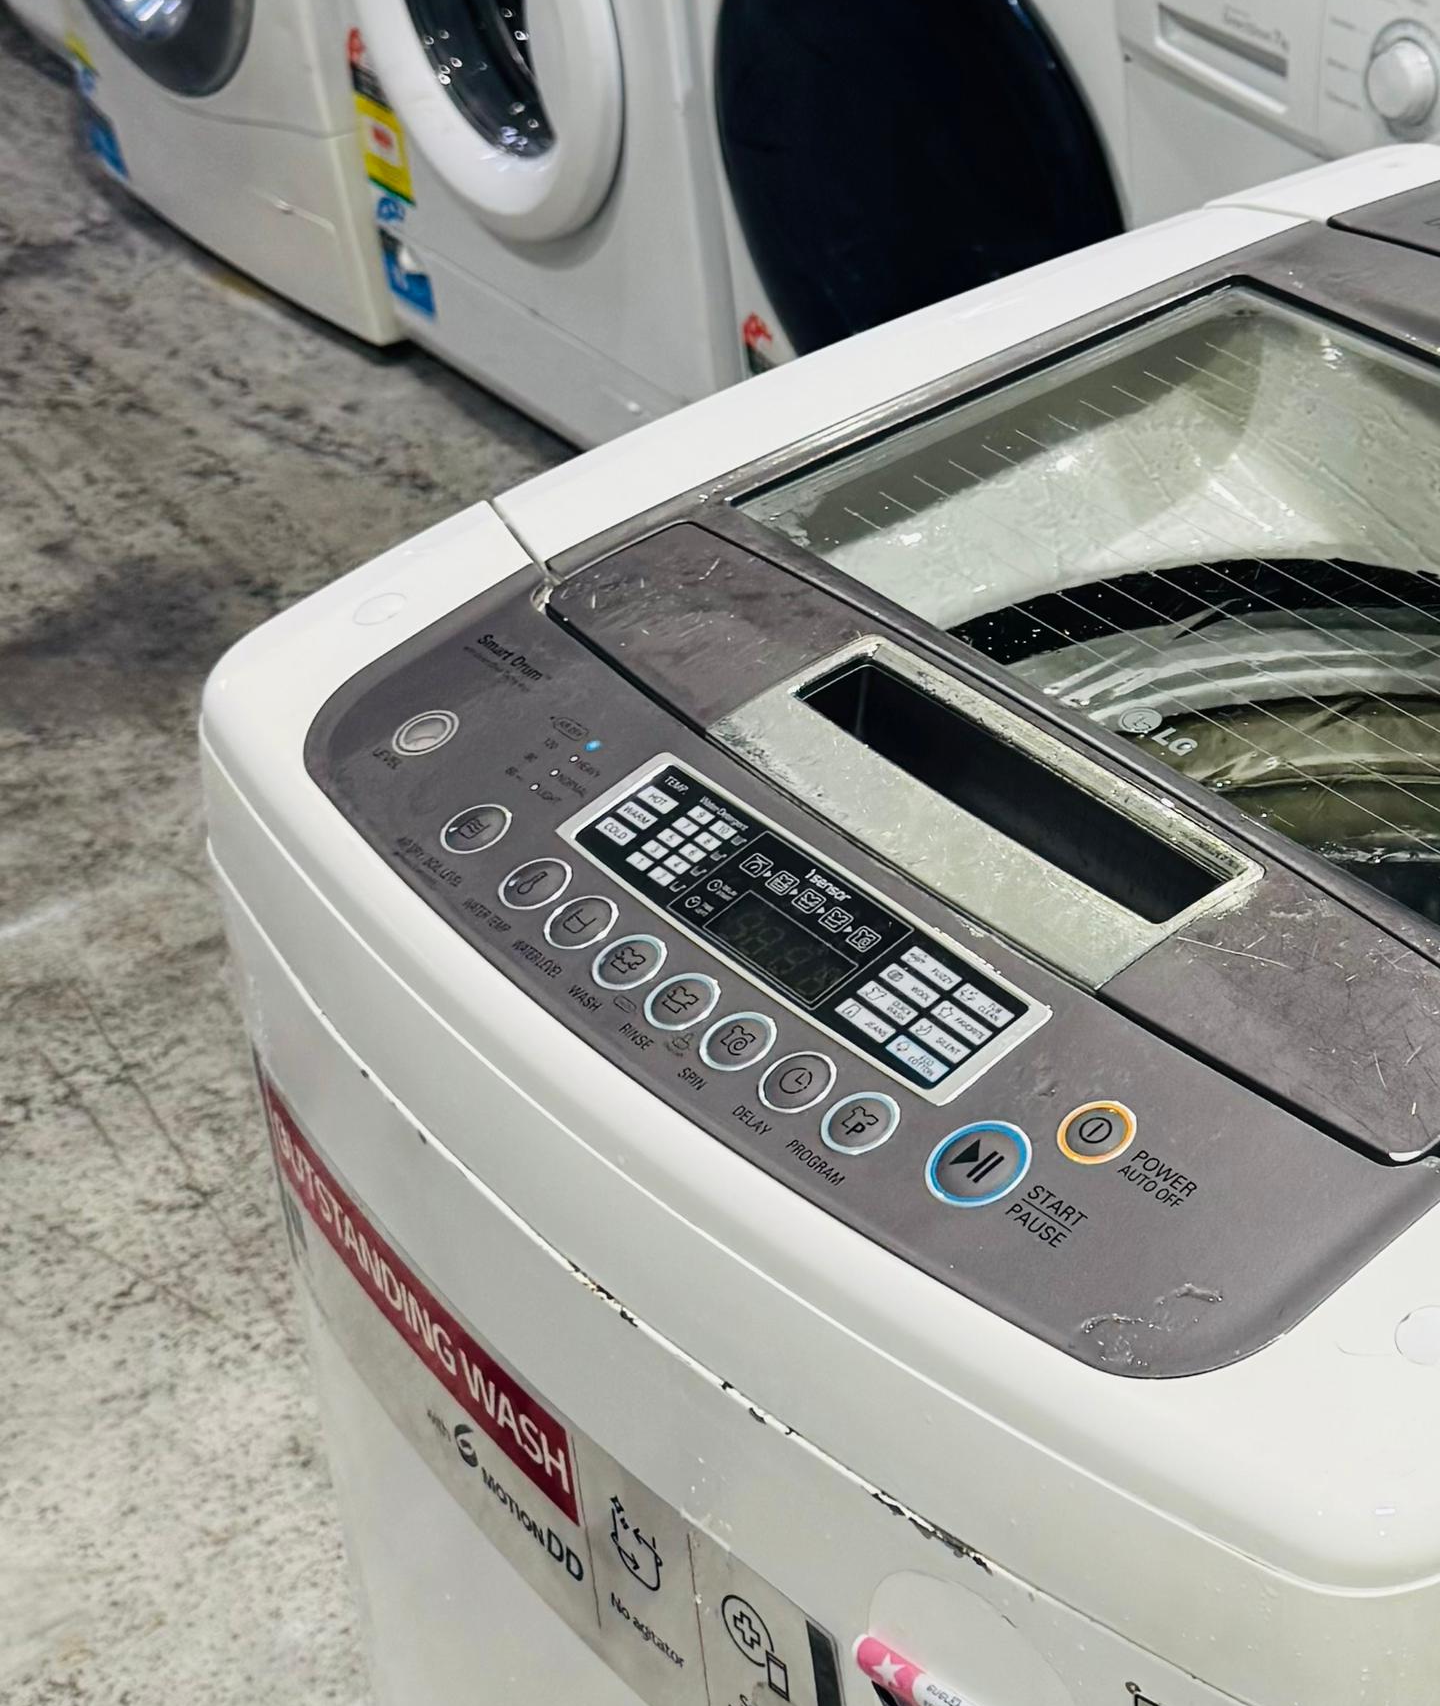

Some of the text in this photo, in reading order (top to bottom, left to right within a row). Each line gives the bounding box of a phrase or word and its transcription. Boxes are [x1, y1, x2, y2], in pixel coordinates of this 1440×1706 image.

[477, 633, 514, 664] Smart
[510, 655, 544, 682] Drum
[1151, 726, 1198, 757] LG
[372, 746, 402, 771] LEVEL
[622, 804, 651, 825] WARM
[648, 792, 669, 807] HOT
[603, 821, 629, 841] COLD
[512, 938, 563, 980] WATER LEVEL
[931, 967, 954, 985] FUZZY
[567, 984, 602, 1013] WASH
[910, 985, 931, 1003] WOOL
[618, 1023, 654, 1051] RINSE
[864, 1021, 890, 1039] JEANS
[935, 1036, 962, 1057] SILENT
[677, 1067, 707, 1092] SPIN
[732, 1105, 773, 1136] DELAY
[785, 1139, 846, 1187] PROGRAM
[1131, 1149, 1198, 1198] POWER
[1117, 1164, 1185, 1209] AUTO OFF
[1027, 1184, 1089, 1227] START
[1005, 1203, 1068, 1249] PAUSE
[272, 1111, 571, 1495] OUTSTANDING WASH
[610, 1591, 685, 1669] No agitator
